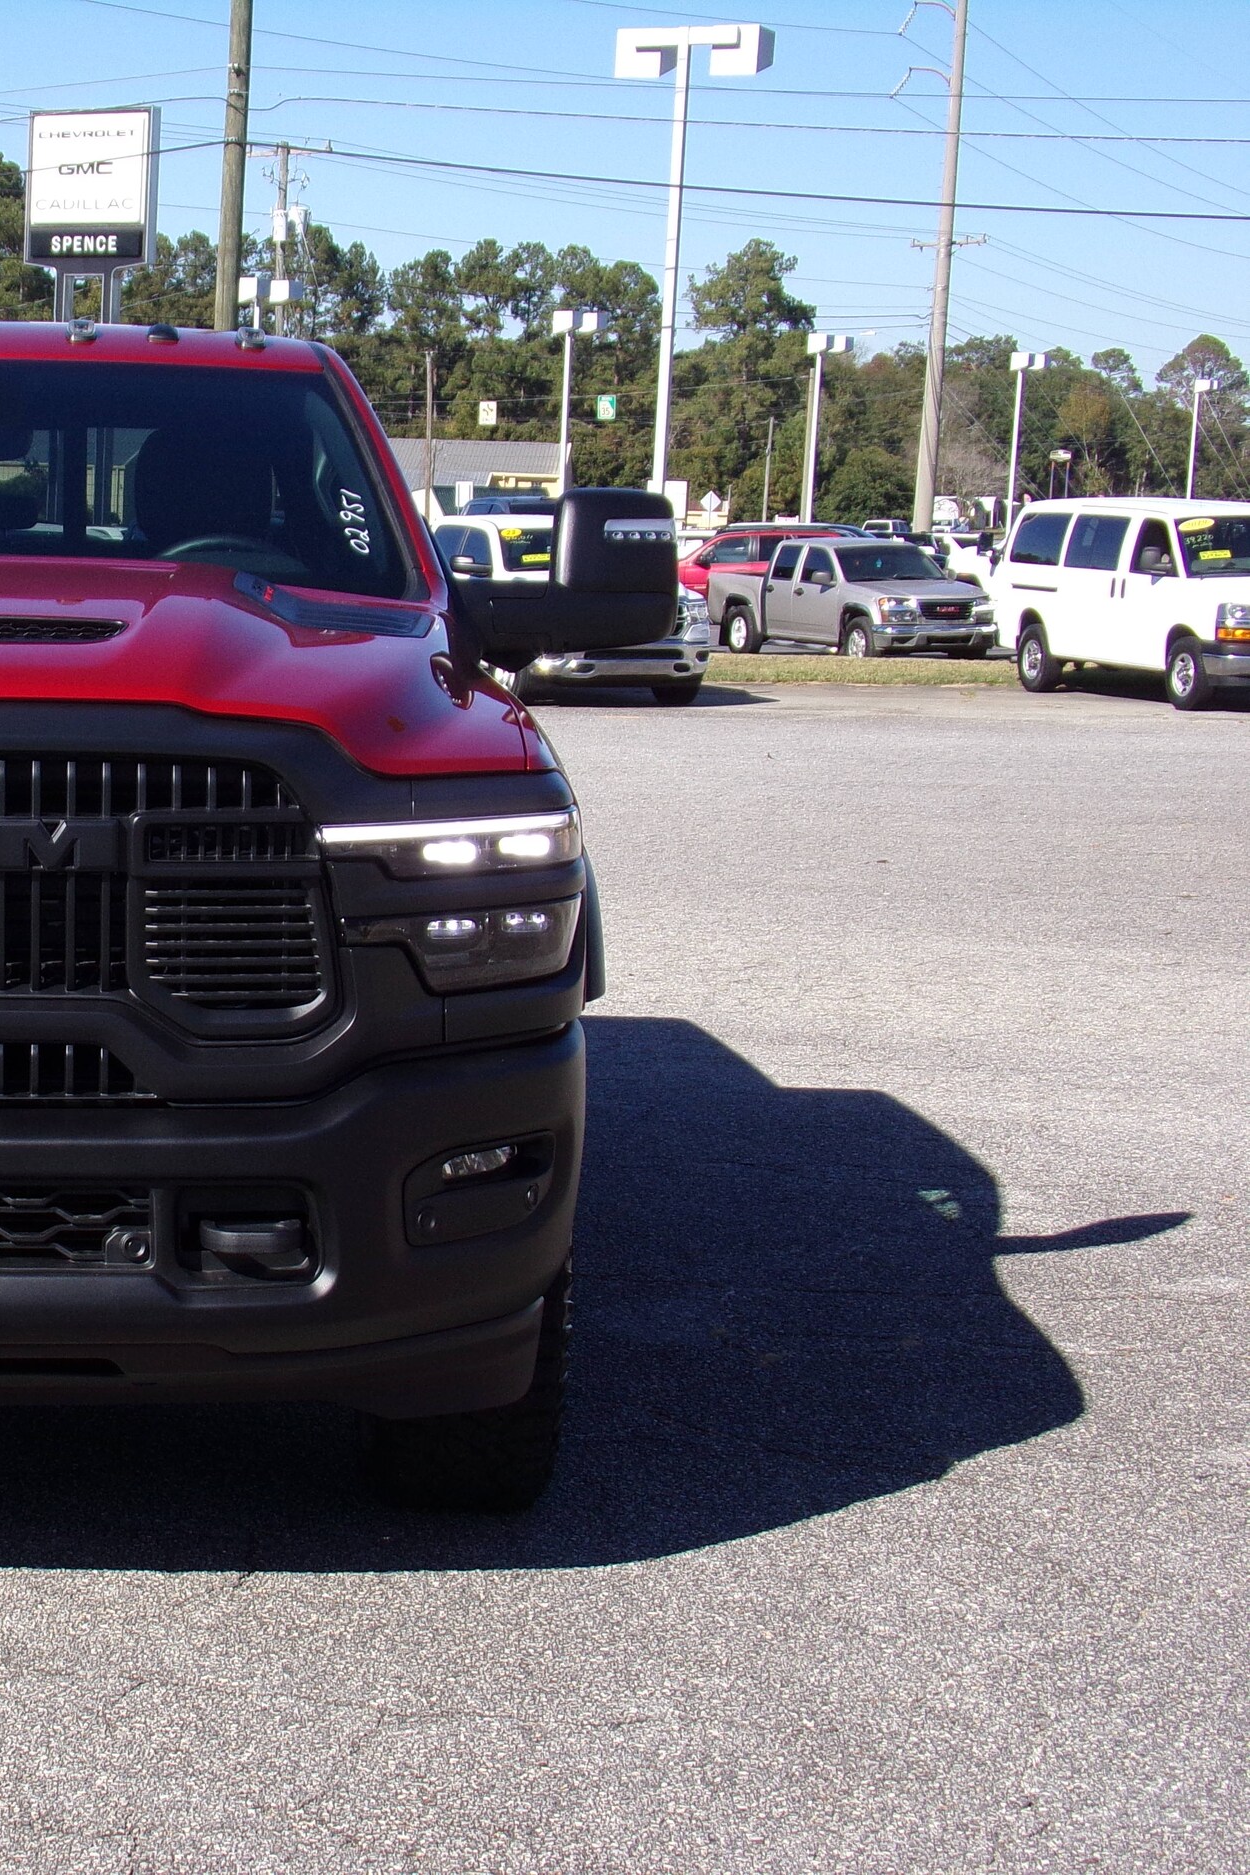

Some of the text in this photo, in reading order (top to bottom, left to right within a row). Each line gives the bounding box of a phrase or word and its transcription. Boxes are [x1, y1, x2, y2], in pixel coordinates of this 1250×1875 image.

[39, 129, 135, 139] CHEVROLET
[58, 161, 113, 175] GMC
[35, 197, 134, 211] CADILLAC
[51, 234, 118, 253] SPENCE
[601, 406, 611, 416] 35
[339, 488, 370, 554] 02951
